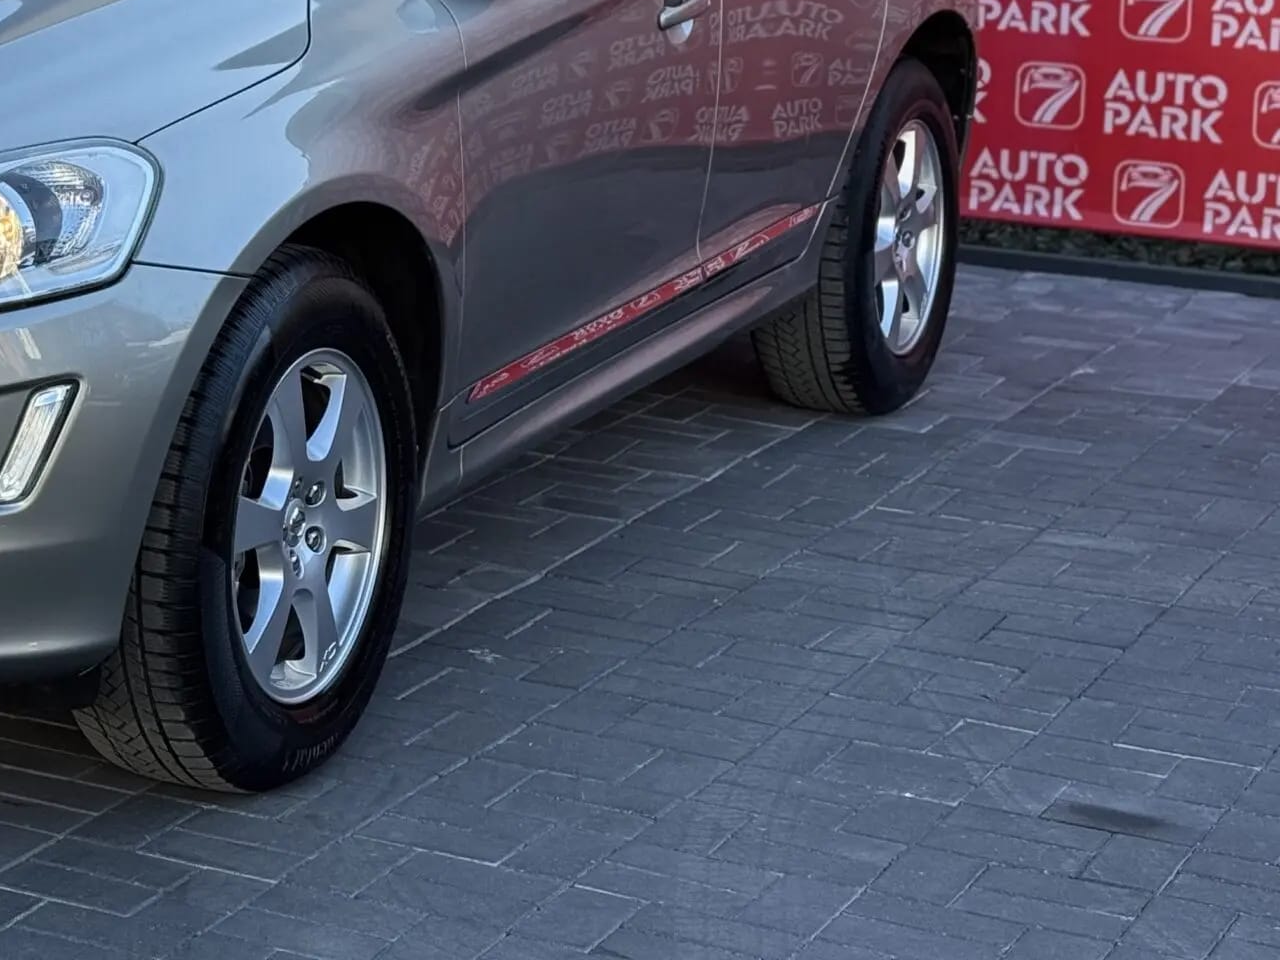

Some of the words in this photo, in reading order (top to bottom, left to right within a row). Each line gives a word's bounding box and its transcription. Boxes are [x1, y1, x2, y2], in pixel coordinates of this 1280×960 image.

[1105, 69, 1227, 109] AUTO
[1104, 101, 1222, 143] PARK
[970, 148, 1088, 186] AUTO
[969, 180, 1083, 221] PARK
